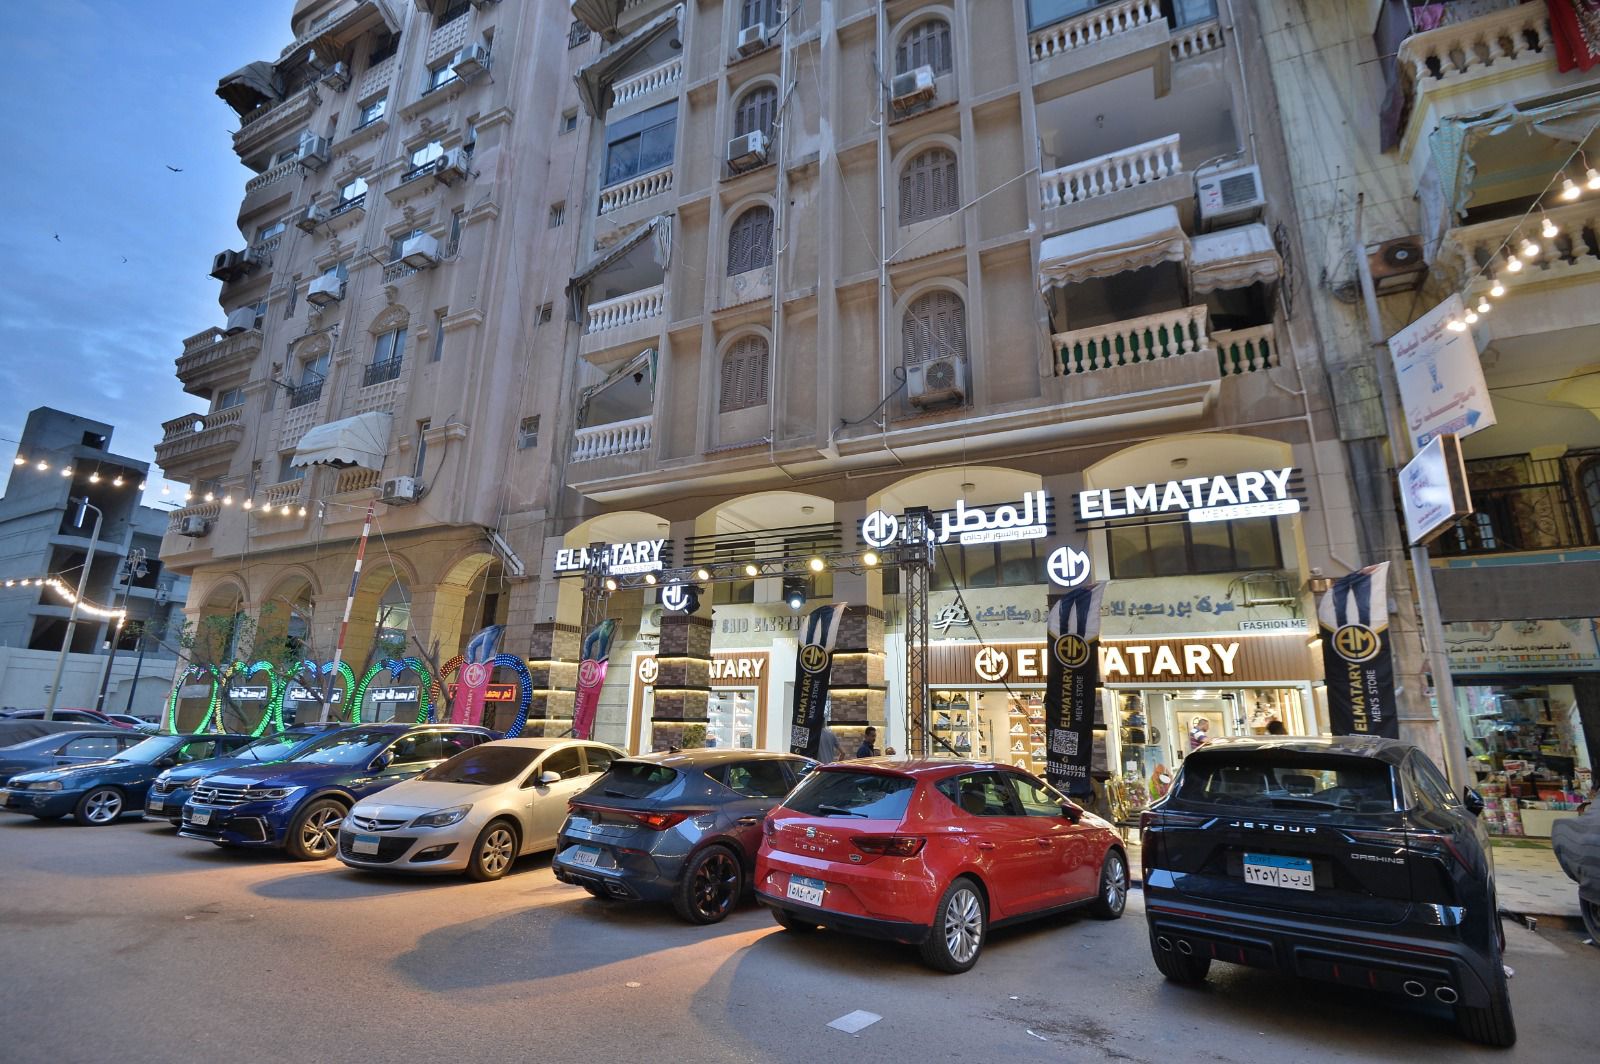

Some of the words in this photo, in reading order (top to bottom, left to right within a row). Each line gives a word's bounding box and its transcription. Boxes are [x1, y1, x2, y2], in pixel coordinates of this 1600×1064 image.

[1079, 467, 1293, 519] ELMATARY
[1243, 620, 1288, 630] FASHION
[1075, 675, 1084, 697] STORE
[1366, 669, 1379, 695] STORE
[796, 672, 812, 725] ELMATARY
[1061, 667, 1073, 728] ELMATARY
[1348, 662, 1369, 732] ELMATARY
[1370, 698, 1382, 722] MEN'S
[1229, 821, 1317, 834] JETOUR
[794, 842, 825, 853] LEON
[1351, 853, 1405, 865] DASHING
